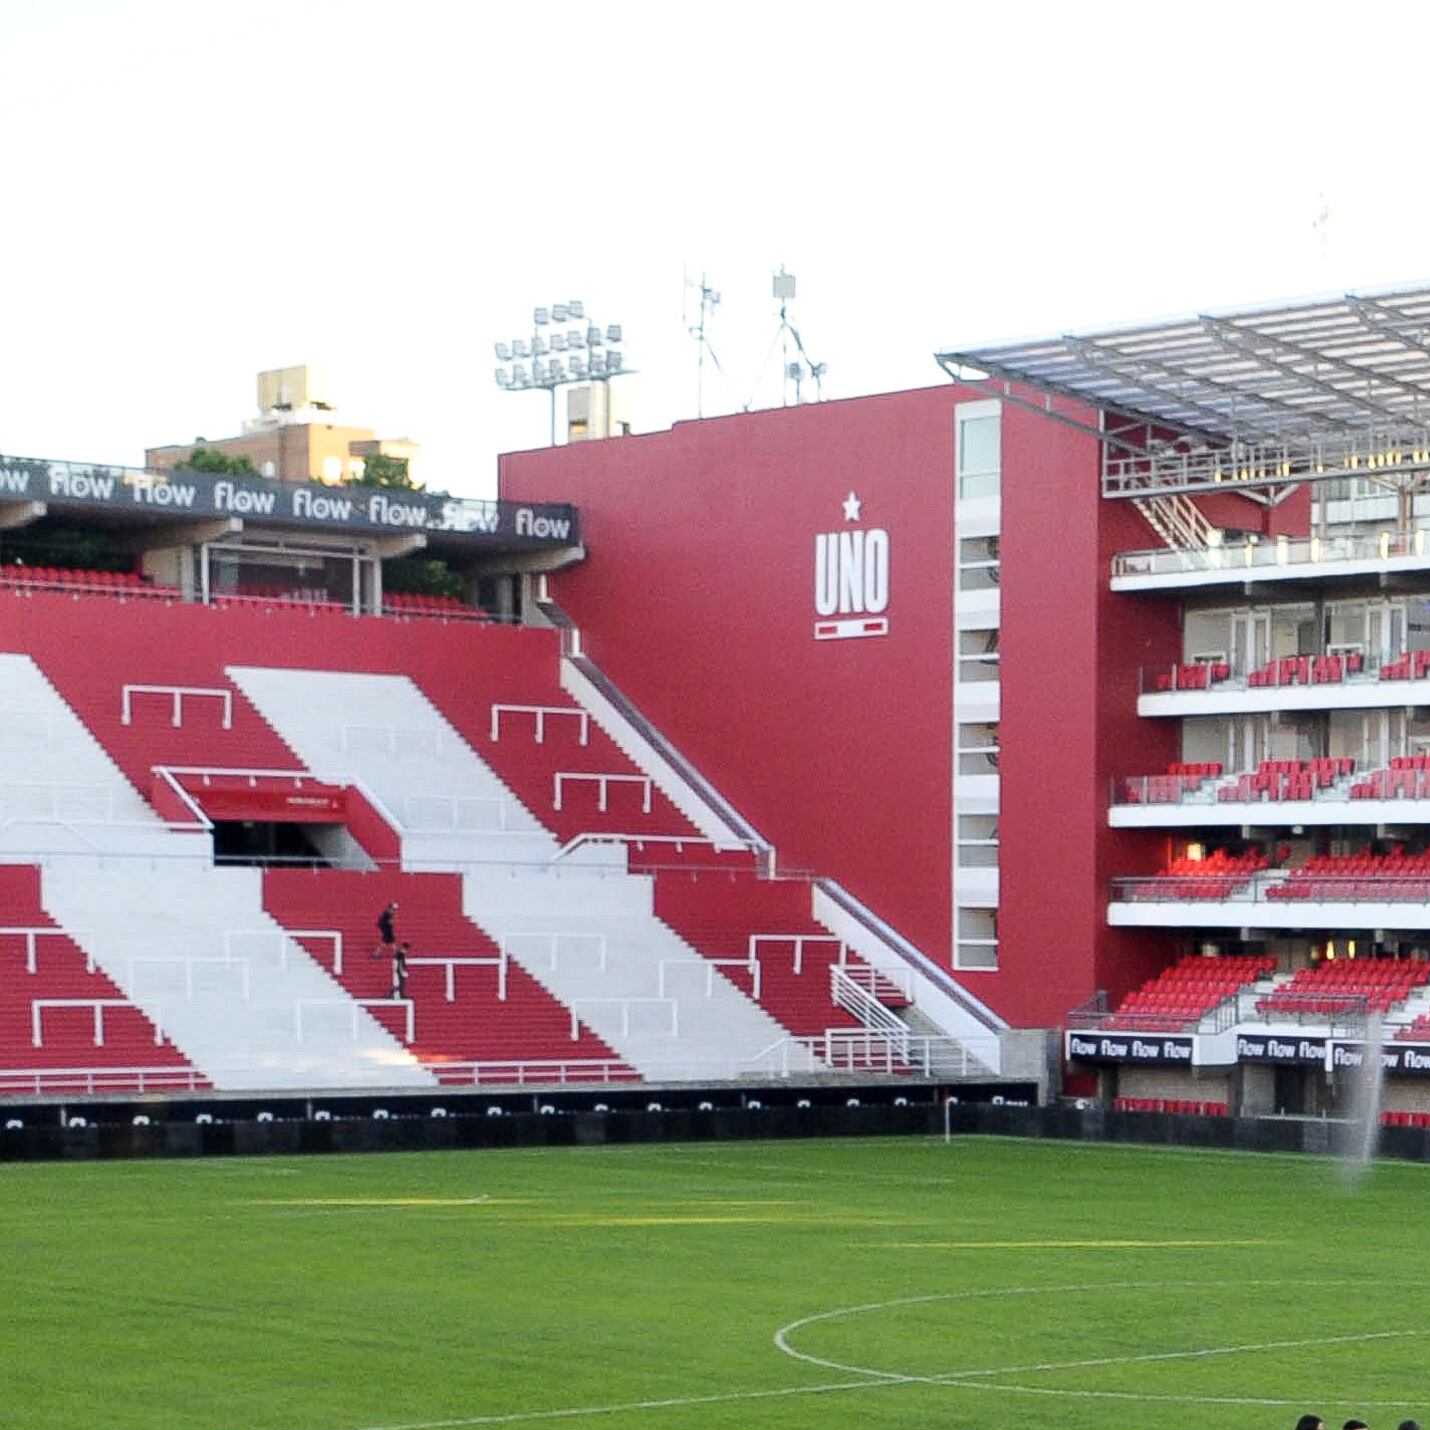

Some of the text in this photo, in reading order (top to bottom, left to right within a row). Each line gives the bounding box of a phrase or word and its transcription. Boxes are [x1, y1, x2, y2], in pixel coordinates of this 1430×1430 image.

[48, 465, 114, 498] flow
[133, 474, 195, 507] flow
[214, 482, 275, 514] flow
[292, 489, 350, 521] flow
[369, 496, 425, 526] flow
[515, 509, 570, 539] flow
[815, 528, 888, 616] UNO
[1070, 1038, 1191, 1059] flow flow flow flow
[1268, 1040, 1294, 1058] flow
[1300, 1041, 1325, 1059] flow
